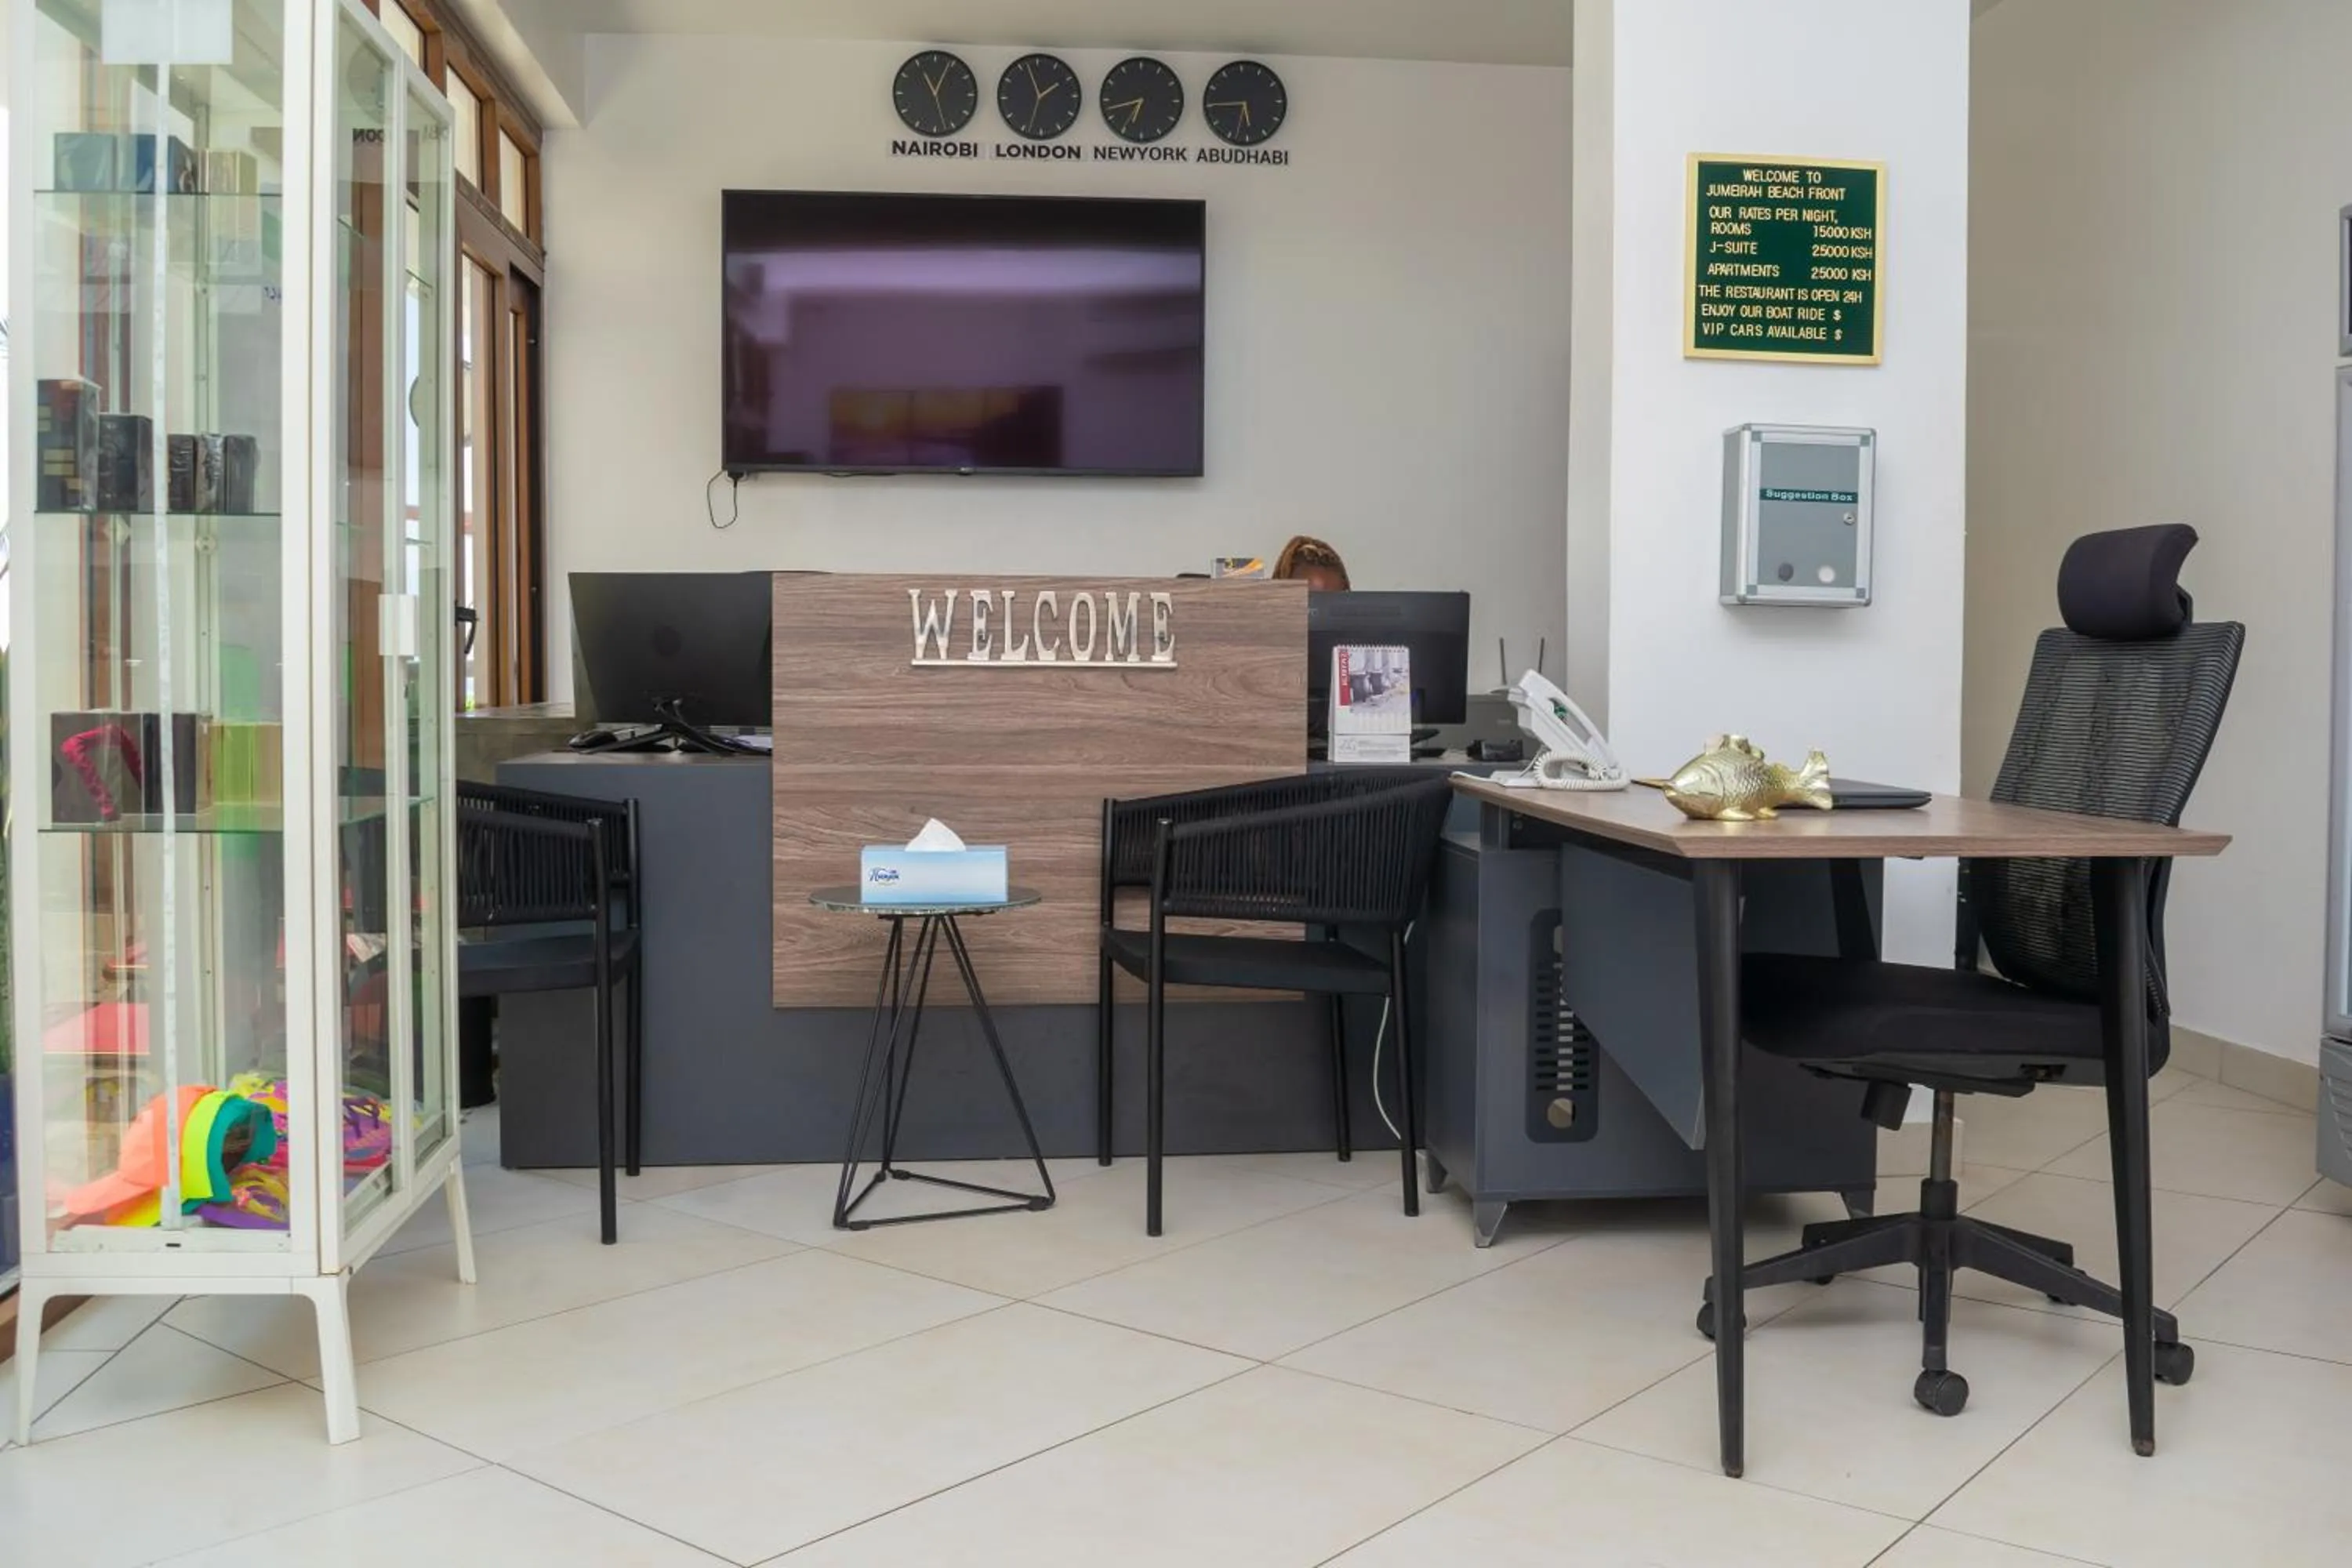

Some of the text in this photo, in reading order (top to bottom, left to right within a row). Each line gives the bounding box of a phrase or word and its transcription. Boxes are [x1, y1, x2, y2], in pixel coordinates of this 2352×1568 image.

[891, 140, 1289, 165] NAIROBI LONDON NEWYORK ABUDHABI
[1743, 169, 1821, 184] WELCOME TO
[1706, 183, 1846, 201] JUMEIRAH BEACH FRONT
[1709, 205, 1732, 219] OUR
[1739, 206, 1772, 220] RATES
[1776, 208, 1798, 221] PER
[1711, 222, 1872, 239] ROOMS 15000 KSH
[1709, 241, 1873, 259] J-SUITE 25000 KSH
[1707, 263, 1871, 281] APARTMENTS 25000 KSH
[1698, 284, 1862, 303] THE RESTAURANT IS OPEN 24H
[1701, 303, 1736, 317] ENJOY
[1740, 304, 1762, 318] OUR
[1766, 306, 1794, 319] BOAT
[1798, 307, 1826, 321] RIDE
[1702, 321, 1724, 335] VIP
[1730, 323, 1763, 336] CARS
[1766, 325, 1828, 339] AVAILABLE
[1766, 488, 1853, 501] Suggestion Box
[908, 589, 1175, 662] WELCOME
